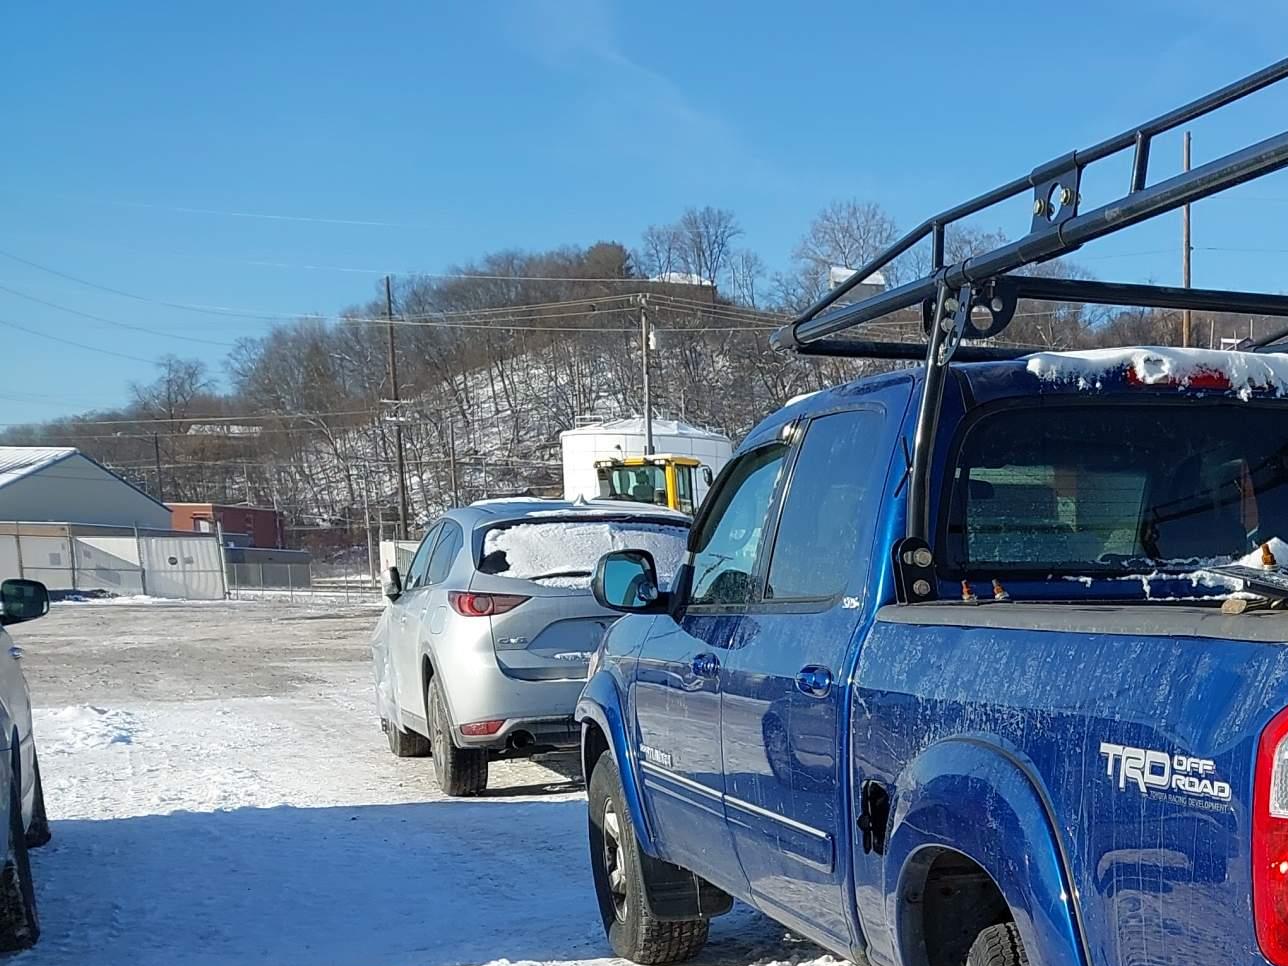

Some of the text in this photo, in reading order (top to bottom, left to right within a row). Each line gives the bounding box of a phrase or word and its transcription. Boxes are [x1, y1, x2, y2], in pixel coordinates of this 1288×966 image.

[1100, 741, 1171, 793] TRD
[1173, 754, 1216, 777] OFF
[1172, 774, 1232, 801] ROAD
[1168, 793, 1188, 805] RACING
[1188, 797, 1229, 813] DEVELOPMENT
